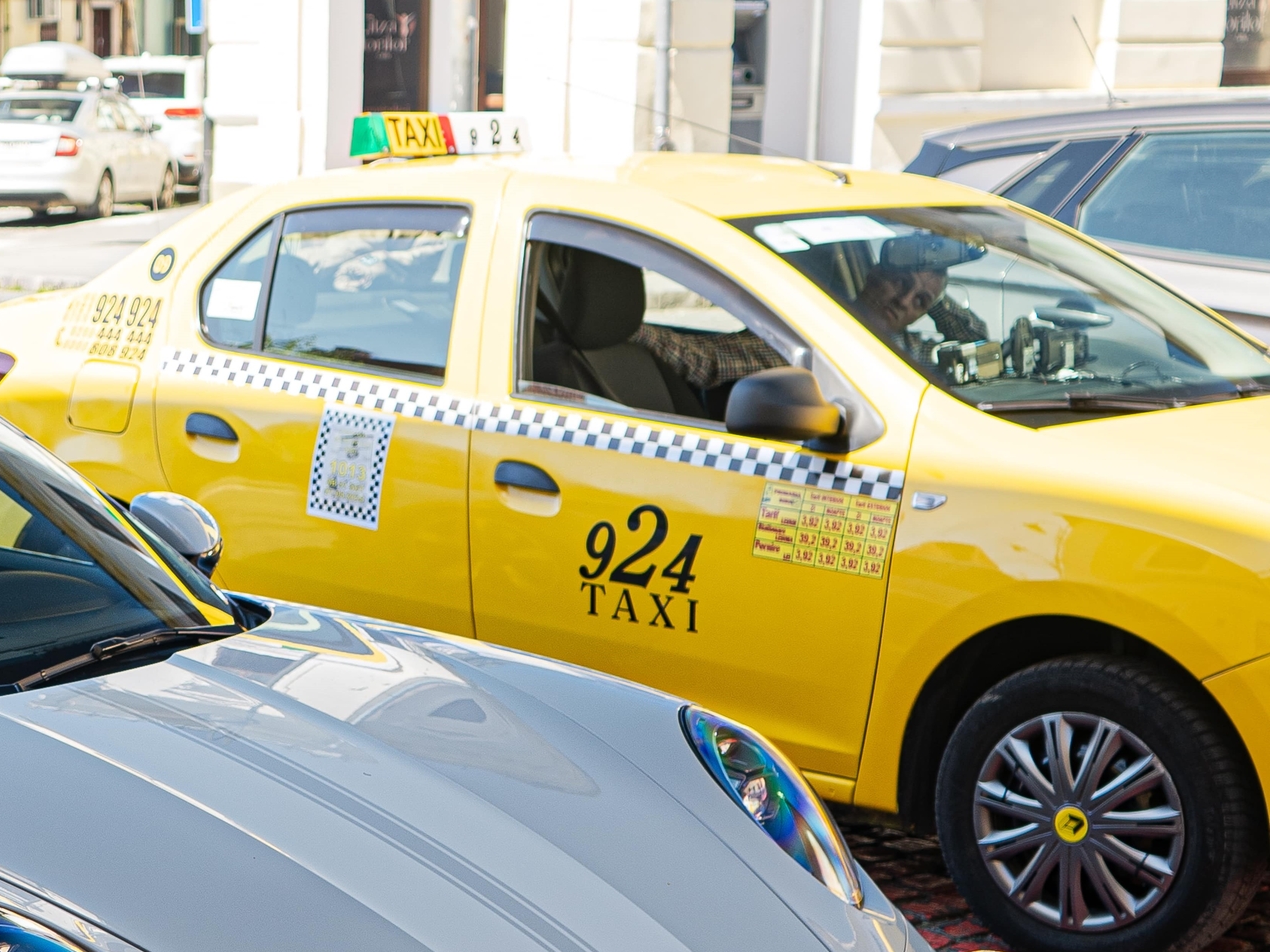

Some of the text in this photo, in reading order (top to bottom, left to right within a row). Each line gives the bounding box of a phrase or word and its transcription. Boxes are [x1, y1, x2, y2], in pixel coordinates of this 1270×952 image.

[388, 118, 443, 148] TAXI
[92, 294, 127, 325] 924
[126, 297, 162, 328] 924
[97, 327, 122, 341] 444
[127, 330, 152, 344] 444
[330, 460, 367, 481] 1013
[578, 504, 704, 594] 924
[580, 581, 699, 633] TAXI
